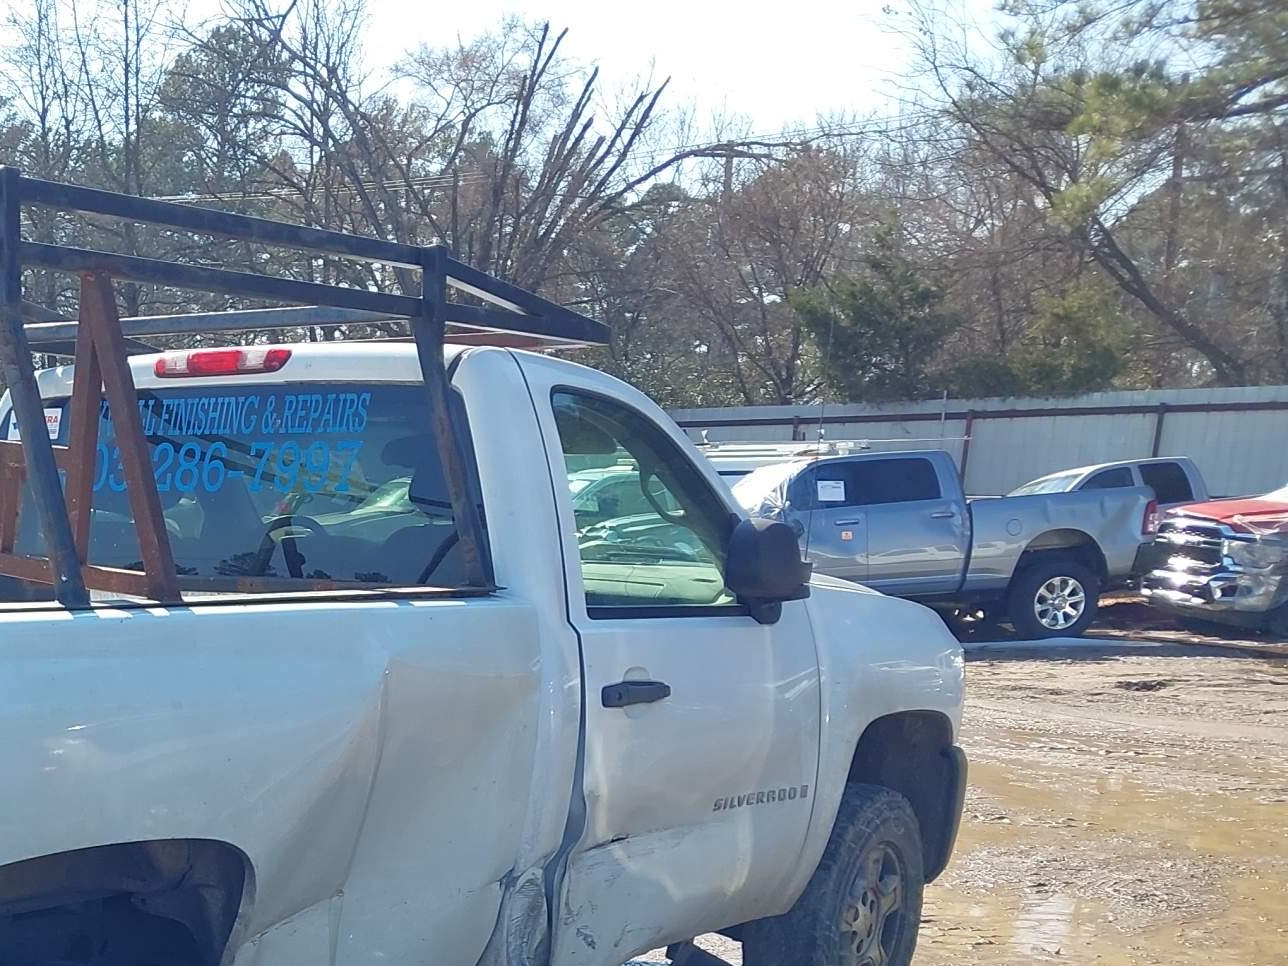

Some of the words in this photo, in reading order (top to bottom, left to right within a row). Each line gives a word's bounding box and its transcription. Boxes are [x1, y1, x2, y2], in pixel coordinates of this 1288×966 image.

[156, 396, 260, 436] FINISHING
[262, 394, 278, 433] &
[279, 392, 371, 433] REPAIRS
[712, 786, 797, 812] SILVERADO
